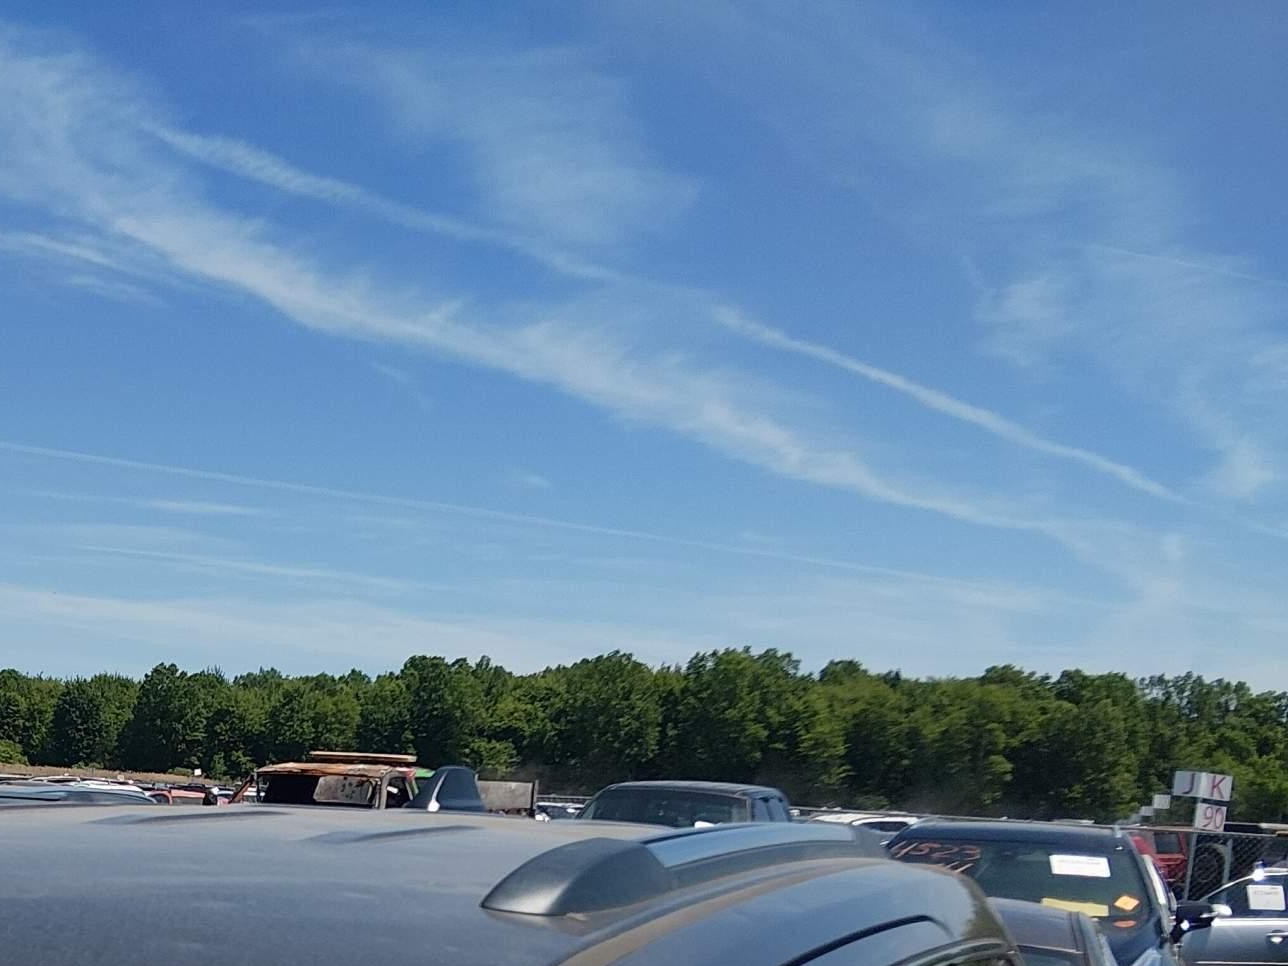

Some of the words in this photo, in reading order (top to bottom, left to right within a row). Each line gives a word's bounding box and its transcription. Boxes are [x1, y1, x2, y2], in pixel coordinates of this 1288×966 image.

[1181, 773, 1196, 794] J
[1212, 775, 1226, 799] K
[1202, 806, 1225, 830] 90
